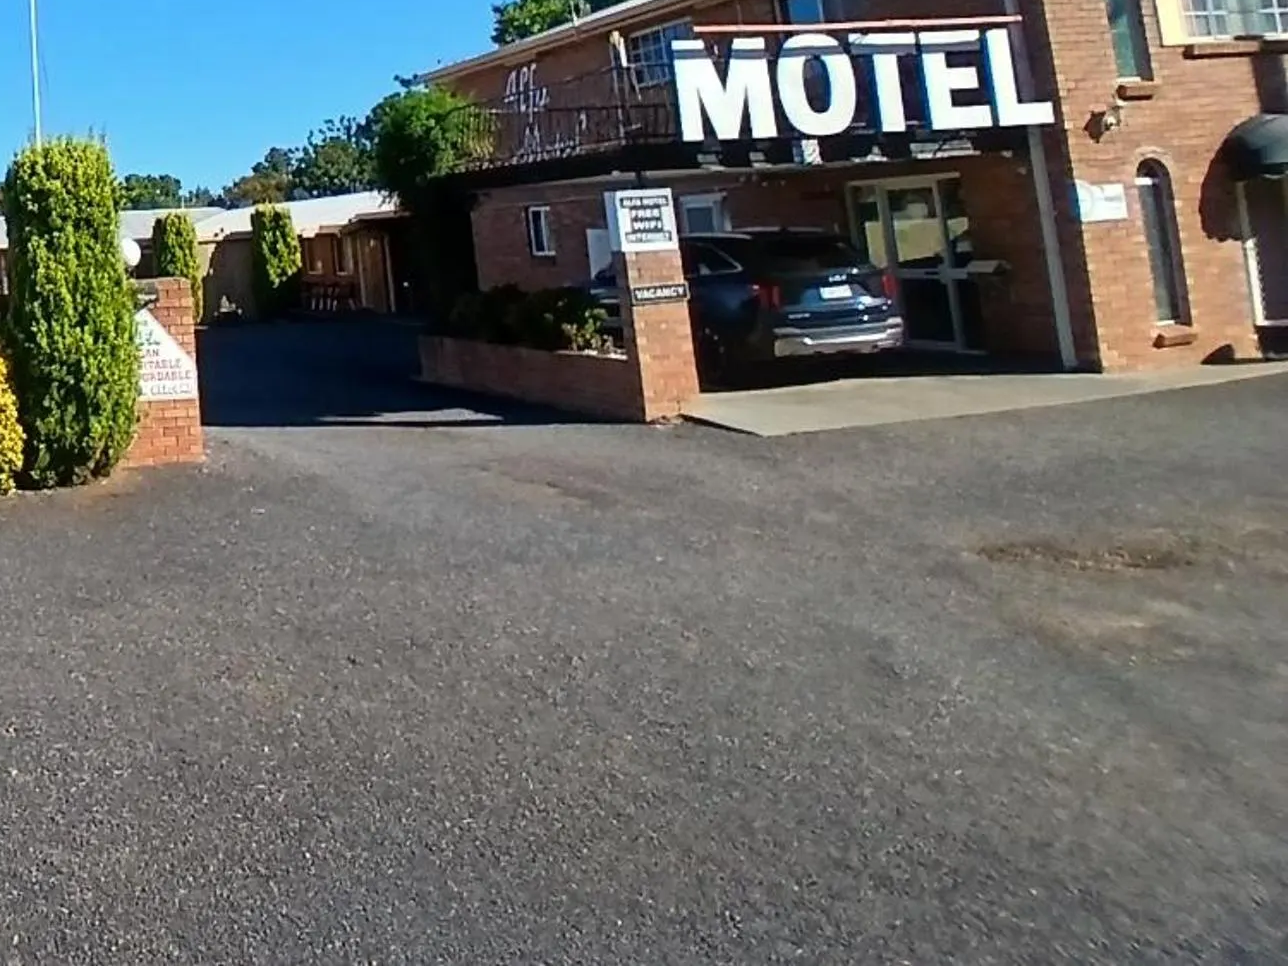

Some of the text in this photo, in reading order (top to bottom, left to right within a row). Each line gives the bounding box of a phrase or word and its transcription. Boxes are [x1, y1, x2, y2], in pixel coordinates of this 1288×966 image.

[671, 28, 1055, 142] MOTEL
[631, 208, 660, 219] FREE
[633, 220, 662, 230] WIFI
[635, 286, 685, 299] VACANCY
